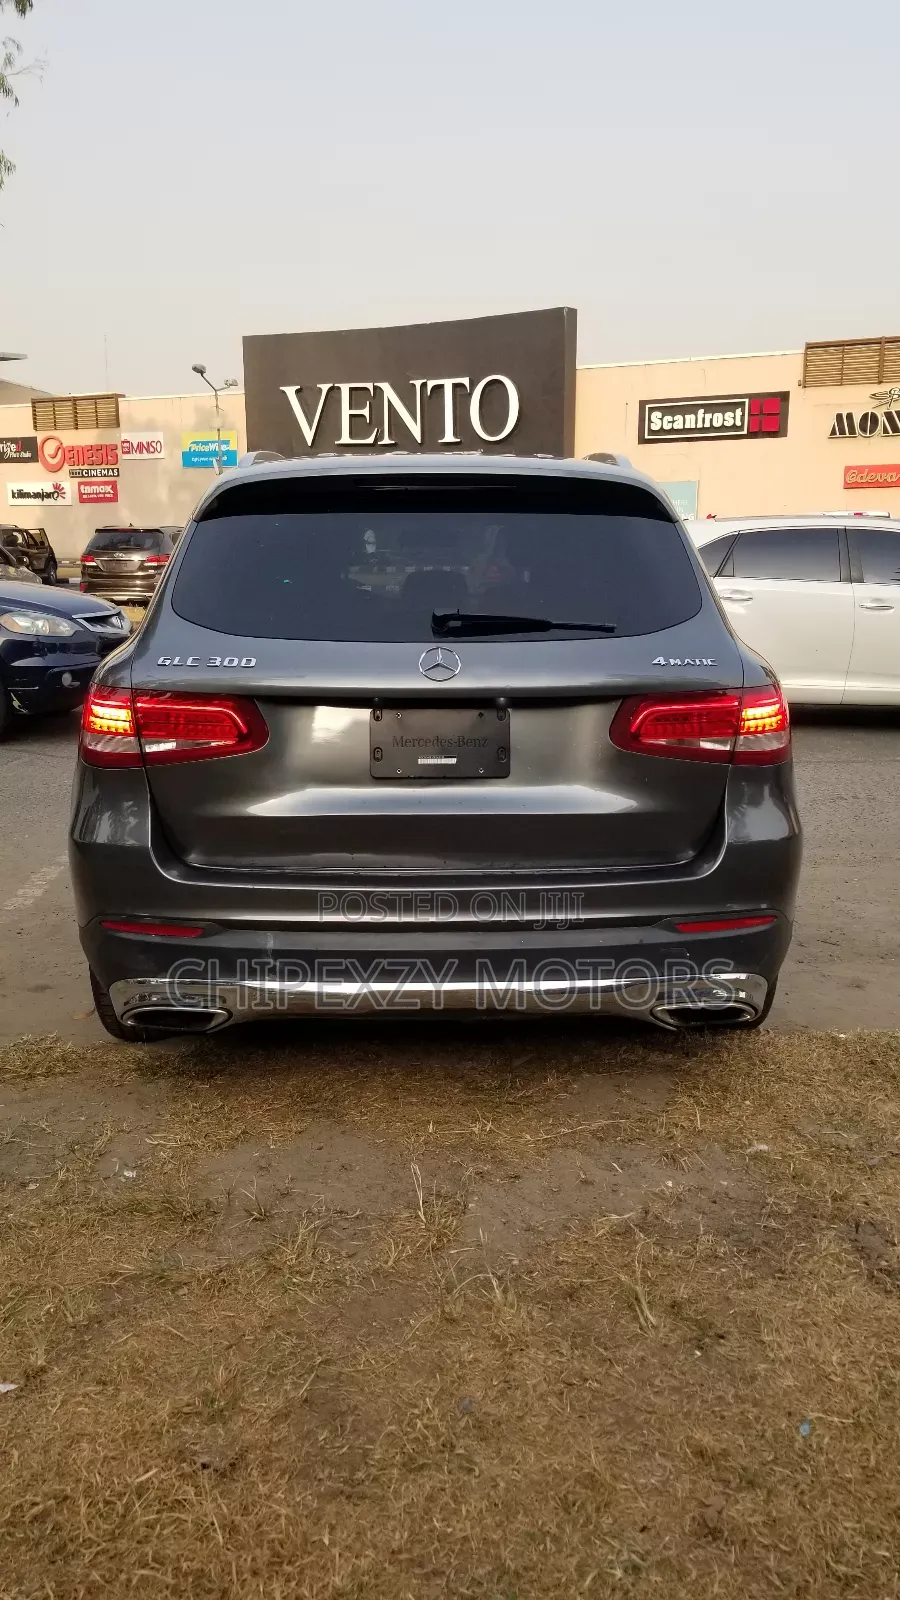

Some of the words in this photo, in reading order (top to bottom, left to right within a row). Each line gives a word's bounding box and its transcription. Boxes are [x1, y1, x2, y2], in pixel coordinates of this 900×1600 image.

[279, 374, 521, 448] VENTO
[650, 407, 743, 431] Scanfrost
[130, 439, 163, 455] MINISO
[190, 442, 230, 452] PriceWie
[82, 468, 118, 477] CINEMAS
[11, 487, 60, 502] kilimanjaro
[157, 656, 201, 668] GLC
[206, 656, 257, 669] 300
[651, 656, 718, 667] 4MATIC
[392, 735, 489, 748] Mercedes-Benz
